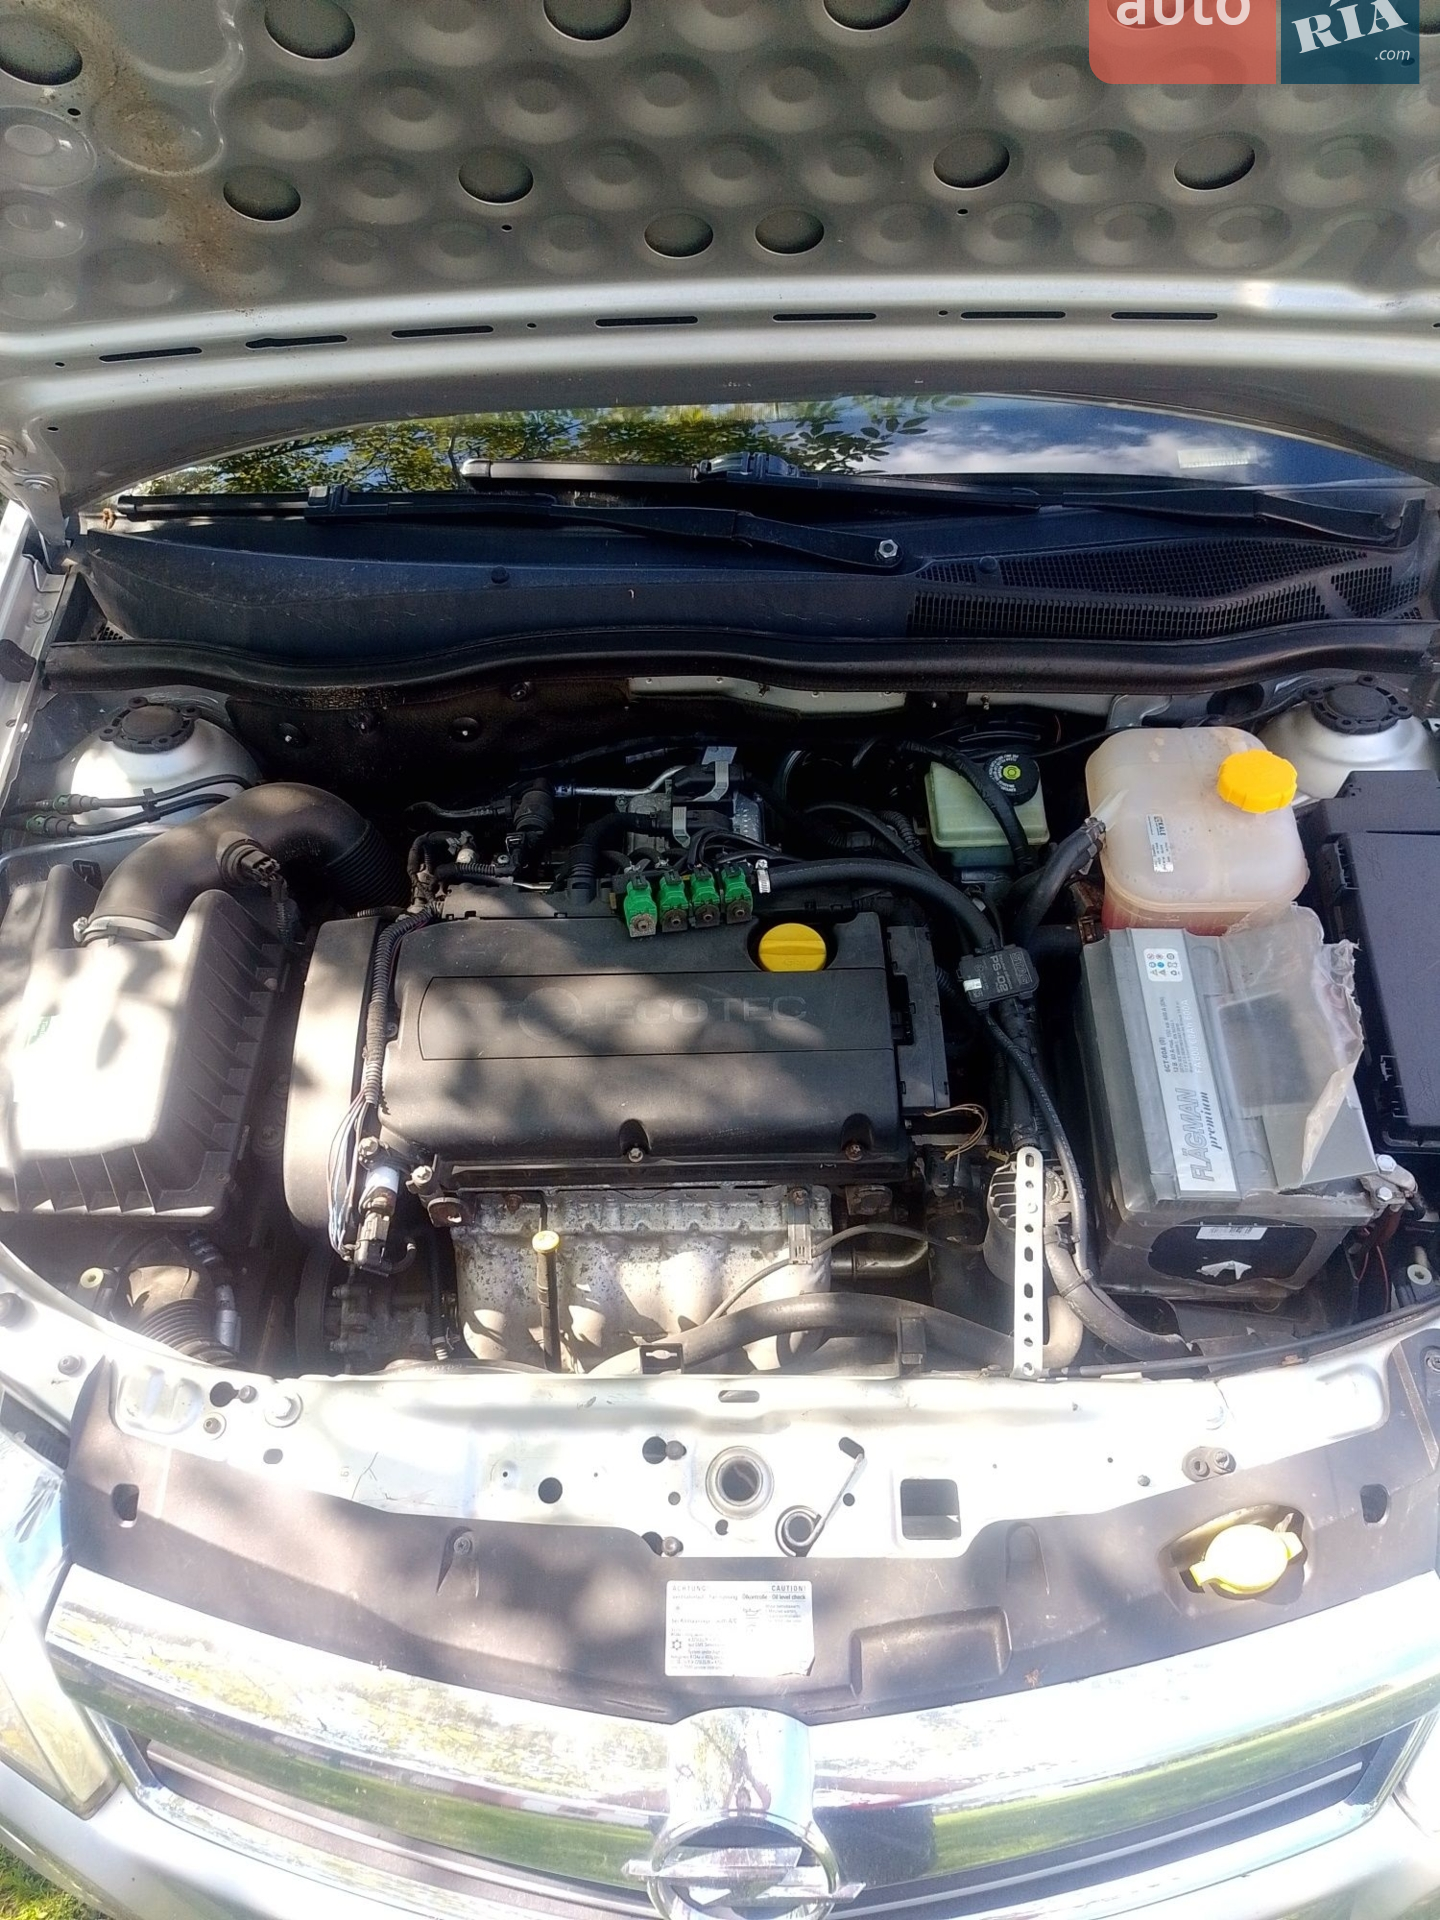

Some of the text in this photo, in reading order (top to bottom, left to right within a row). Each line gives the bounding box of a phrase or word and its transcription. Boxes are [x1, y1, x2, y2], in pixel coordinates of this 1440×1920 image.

[991, 956, 1008, 993] PS-02
[604, 996, 808, 1024] ECOTEC
[1200, 1092, 1222, 1150] premium
